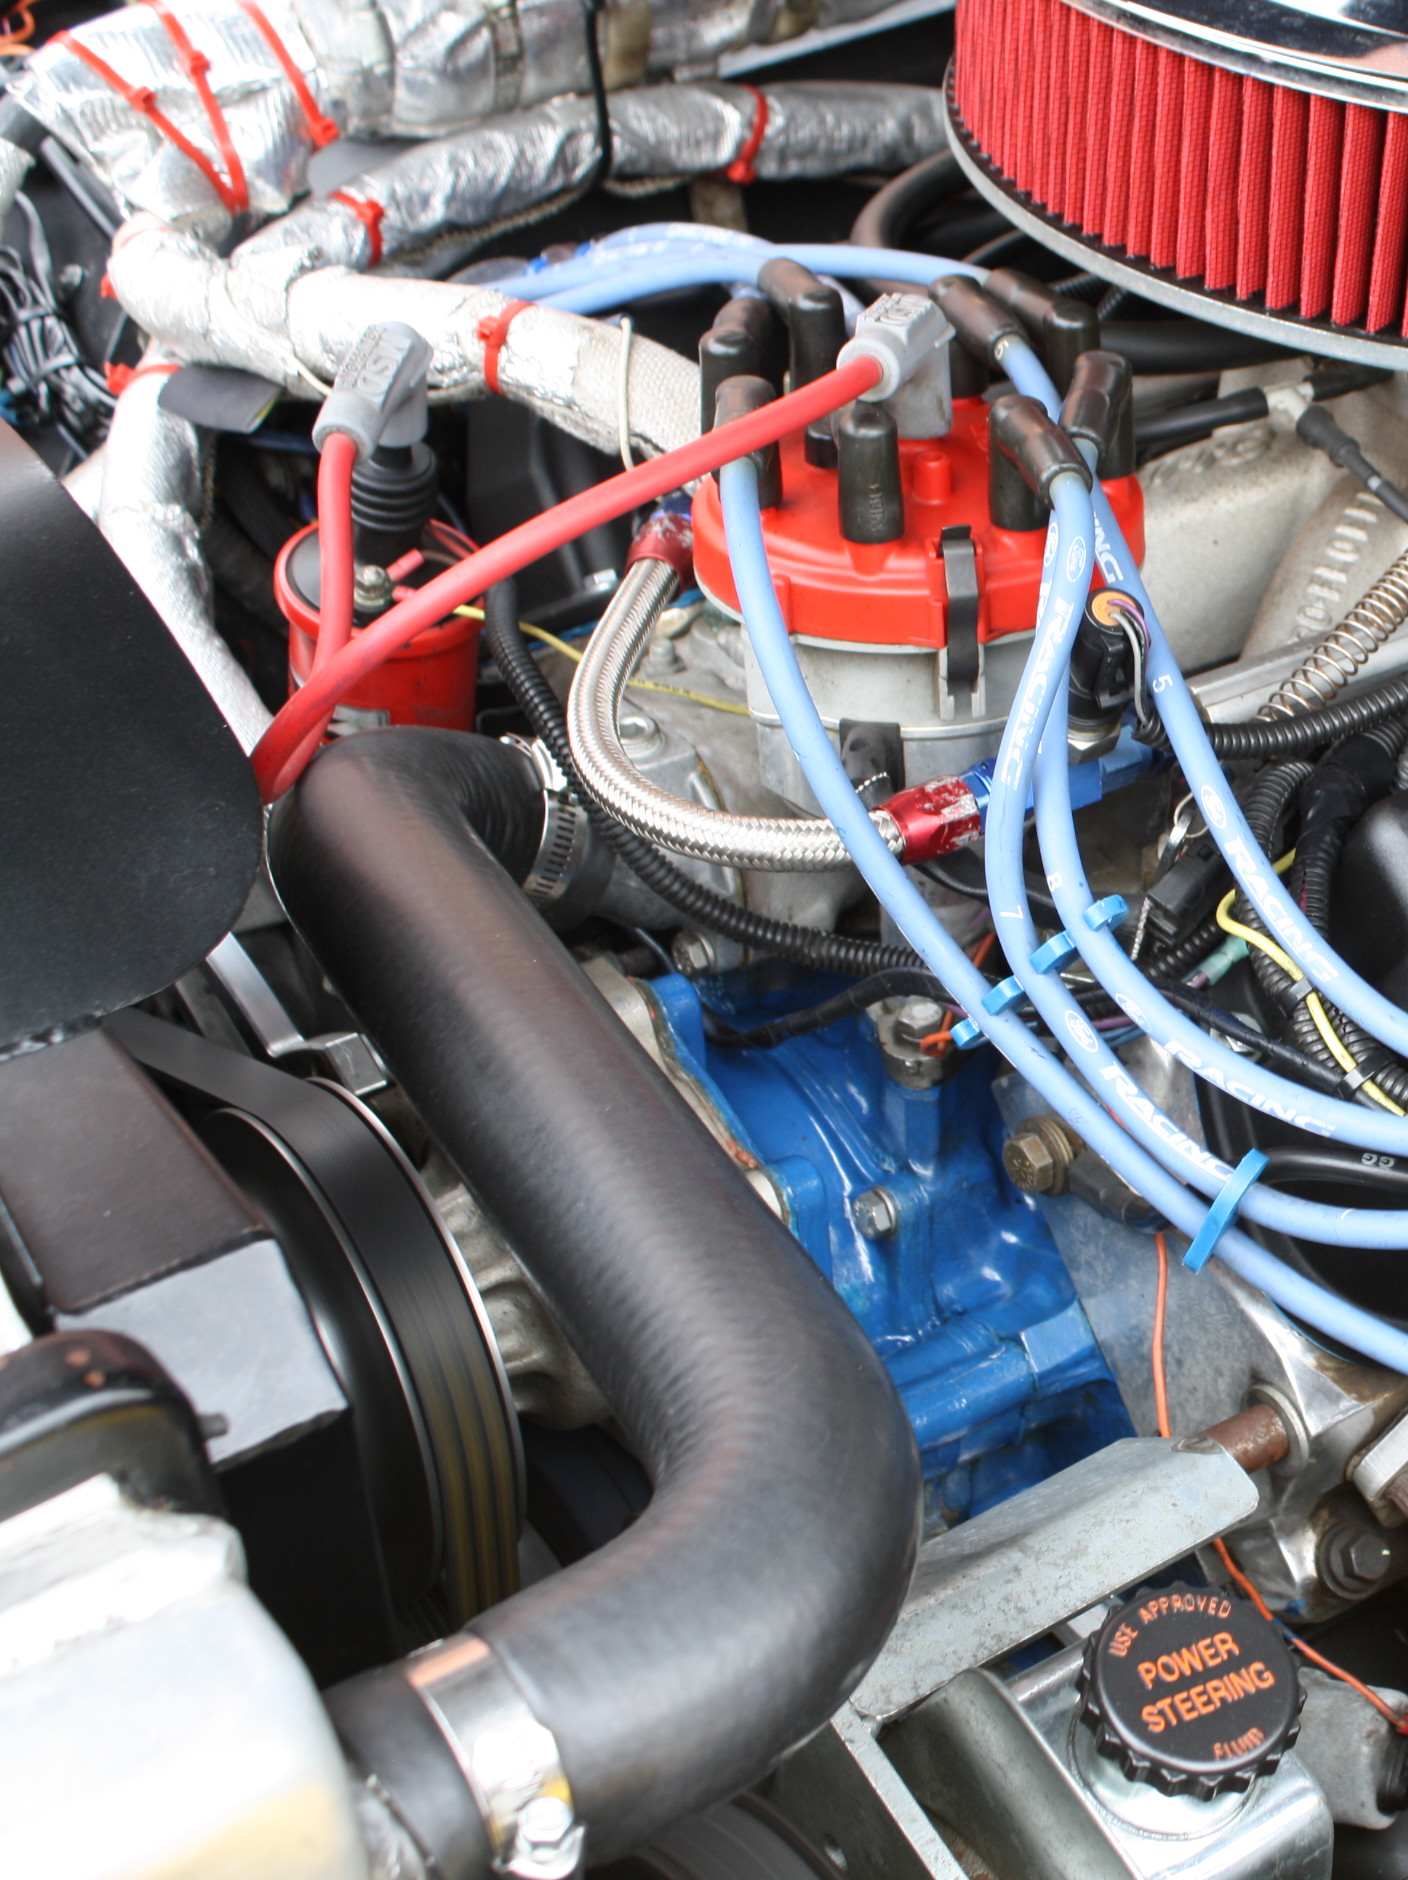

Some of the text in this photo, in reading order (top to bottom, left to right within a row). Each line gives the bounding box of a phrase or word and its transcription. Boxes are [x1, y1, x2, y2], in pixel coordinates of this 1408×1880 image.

[1153, 675, 1173, 693] 5
[1000, 905, 1024, 920] 7
[1224, 836, 1340, 983] RACING
[1109, 1593, 1232, 1658] USE APPROVED
[1137, 1631, 1241, 1690] POWER
[1141, 1661, 1276, 1734] STEERING
[1213, 1727, 1266, 1760] FLUID
